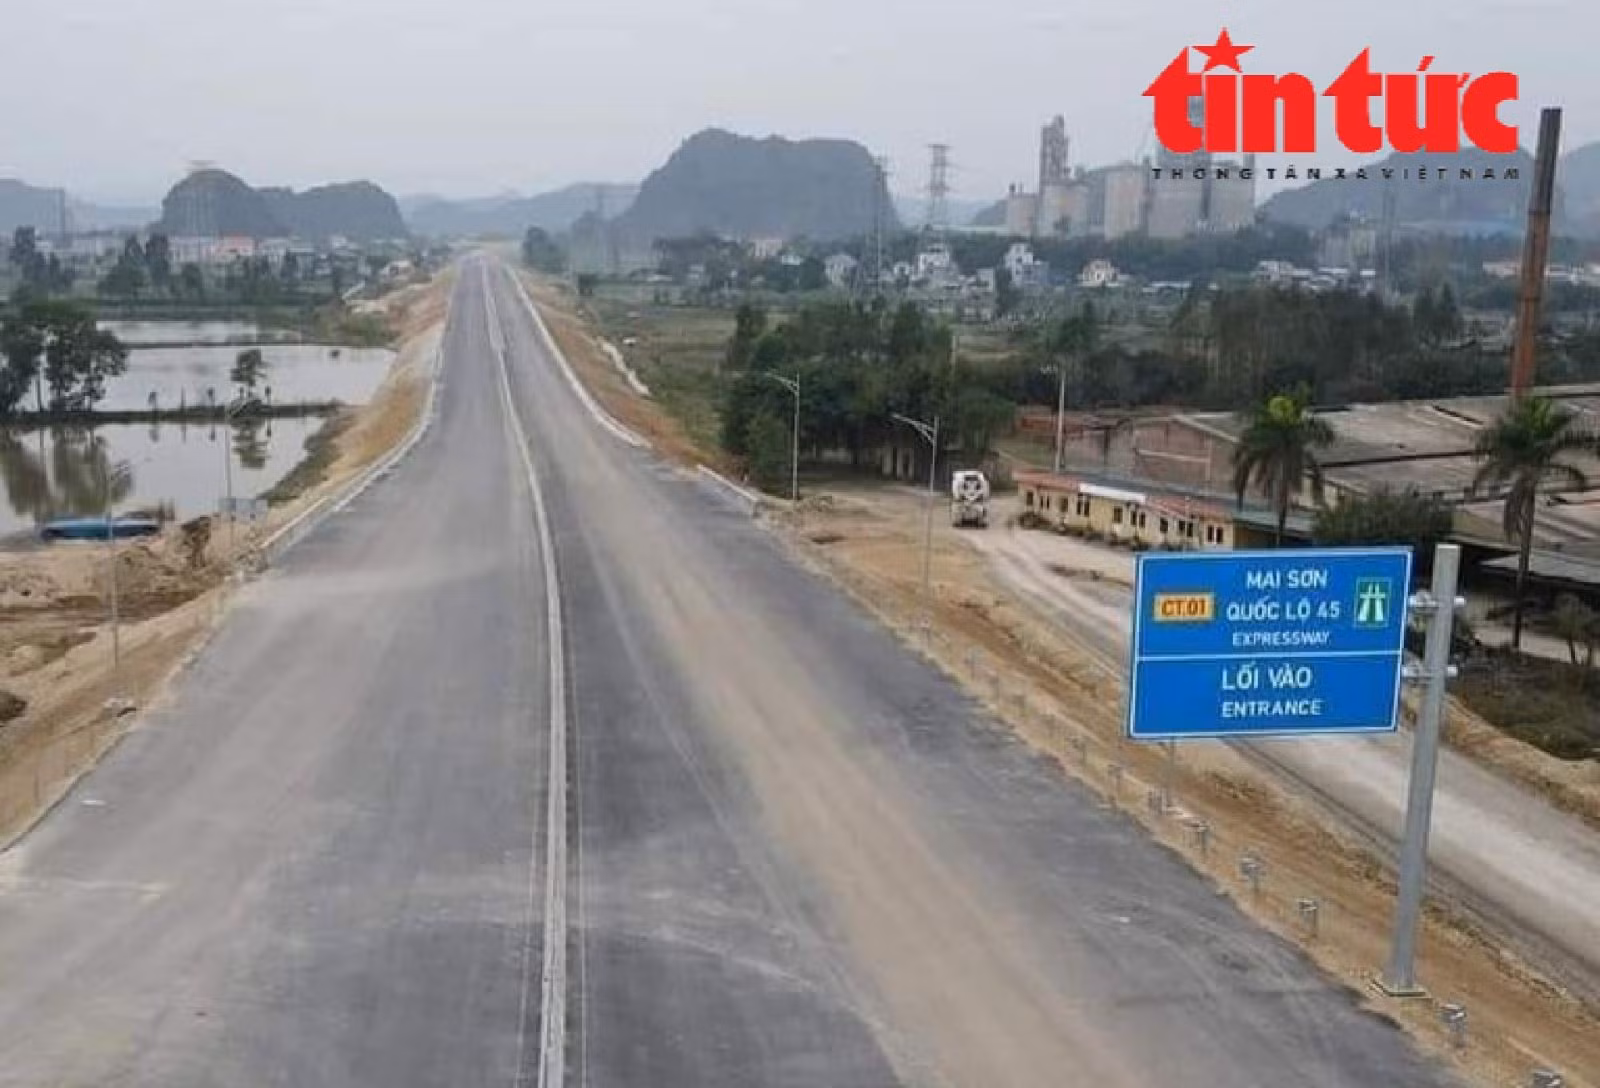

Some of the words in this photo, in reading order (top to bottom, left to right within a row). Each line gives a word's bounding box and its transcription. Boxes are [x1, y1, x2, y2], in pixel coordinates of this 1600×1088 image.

[1226, 595, 1280, 621] QUỐC
[1285, 597, 1310, 624] LỘ
[1316, 600, 1341, 618] 45
[1232, 631, 1330, 647] EXPRESSWAY
[1222, 660, 1259, 690] LỐI
[1267, 663, 1312, 689] VÀO
[1222, 698, 1323, 718] ENTRANCE
